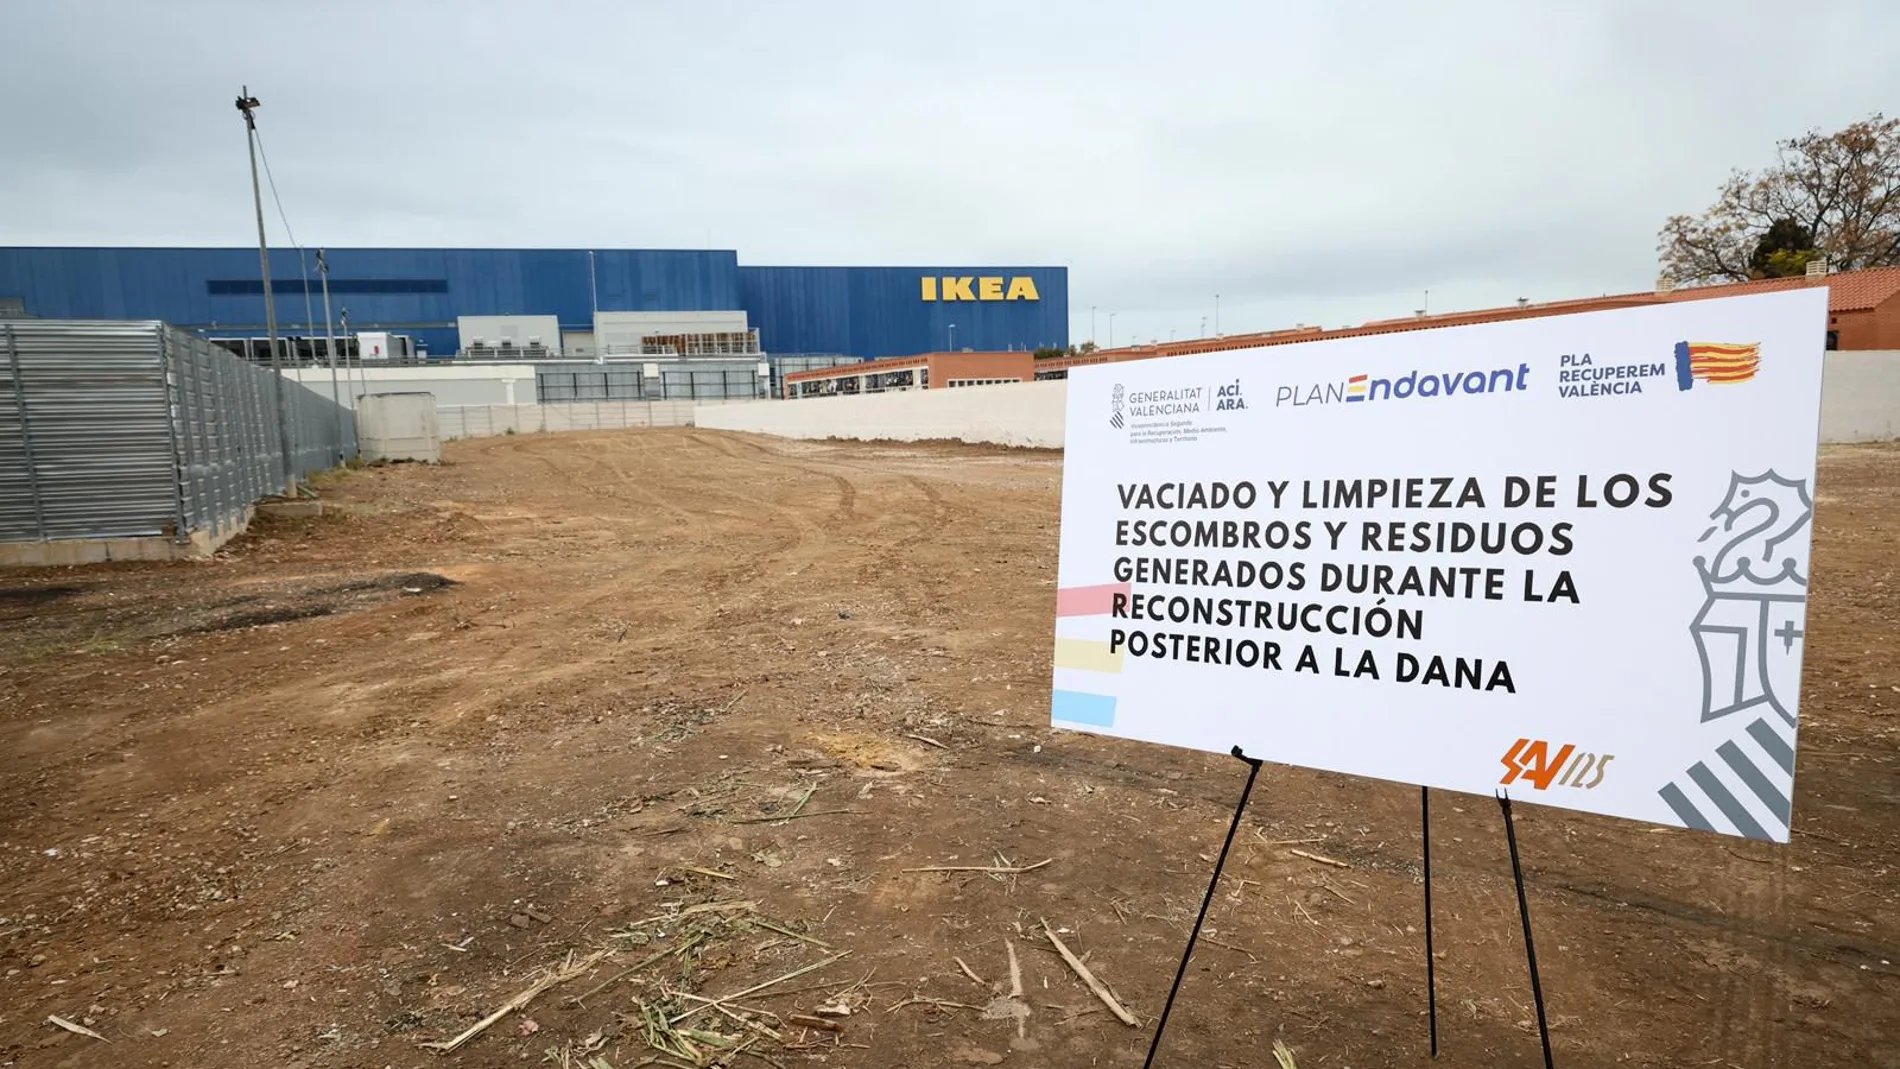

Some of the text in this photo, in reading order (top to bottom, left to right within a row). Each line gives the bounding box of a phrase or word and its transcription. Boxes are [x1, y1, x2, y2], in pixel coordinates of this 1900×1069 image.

[920, 276, 1040, 301] IKEA
[1559, 363, 1665, 383] RECUPEREM
[1560, 353, 1592, 367] PLA
[1128, 387, 1202, 403] GENERALITAT
[1276, 363, 1530, 407] PLAN Endavant
[1558, 380, 1642, 398] VALÈNCIA
[1129, 402, 1200, 417] VALENCIANA
[1117, 473, 1673, 509] VACIADO Y LIMPIEZA DE LOS
[1115, 520, 1574, 556] ESCOMBROS Y RESIDUOS
[1113, 556, 1581, 604] GENERADOS DURANTE LA
[1112, 592, 1423, 640] RECONSTRUCCIÓN
[1110, 629, 1516, 694] POSTERIOR A LA DANA
